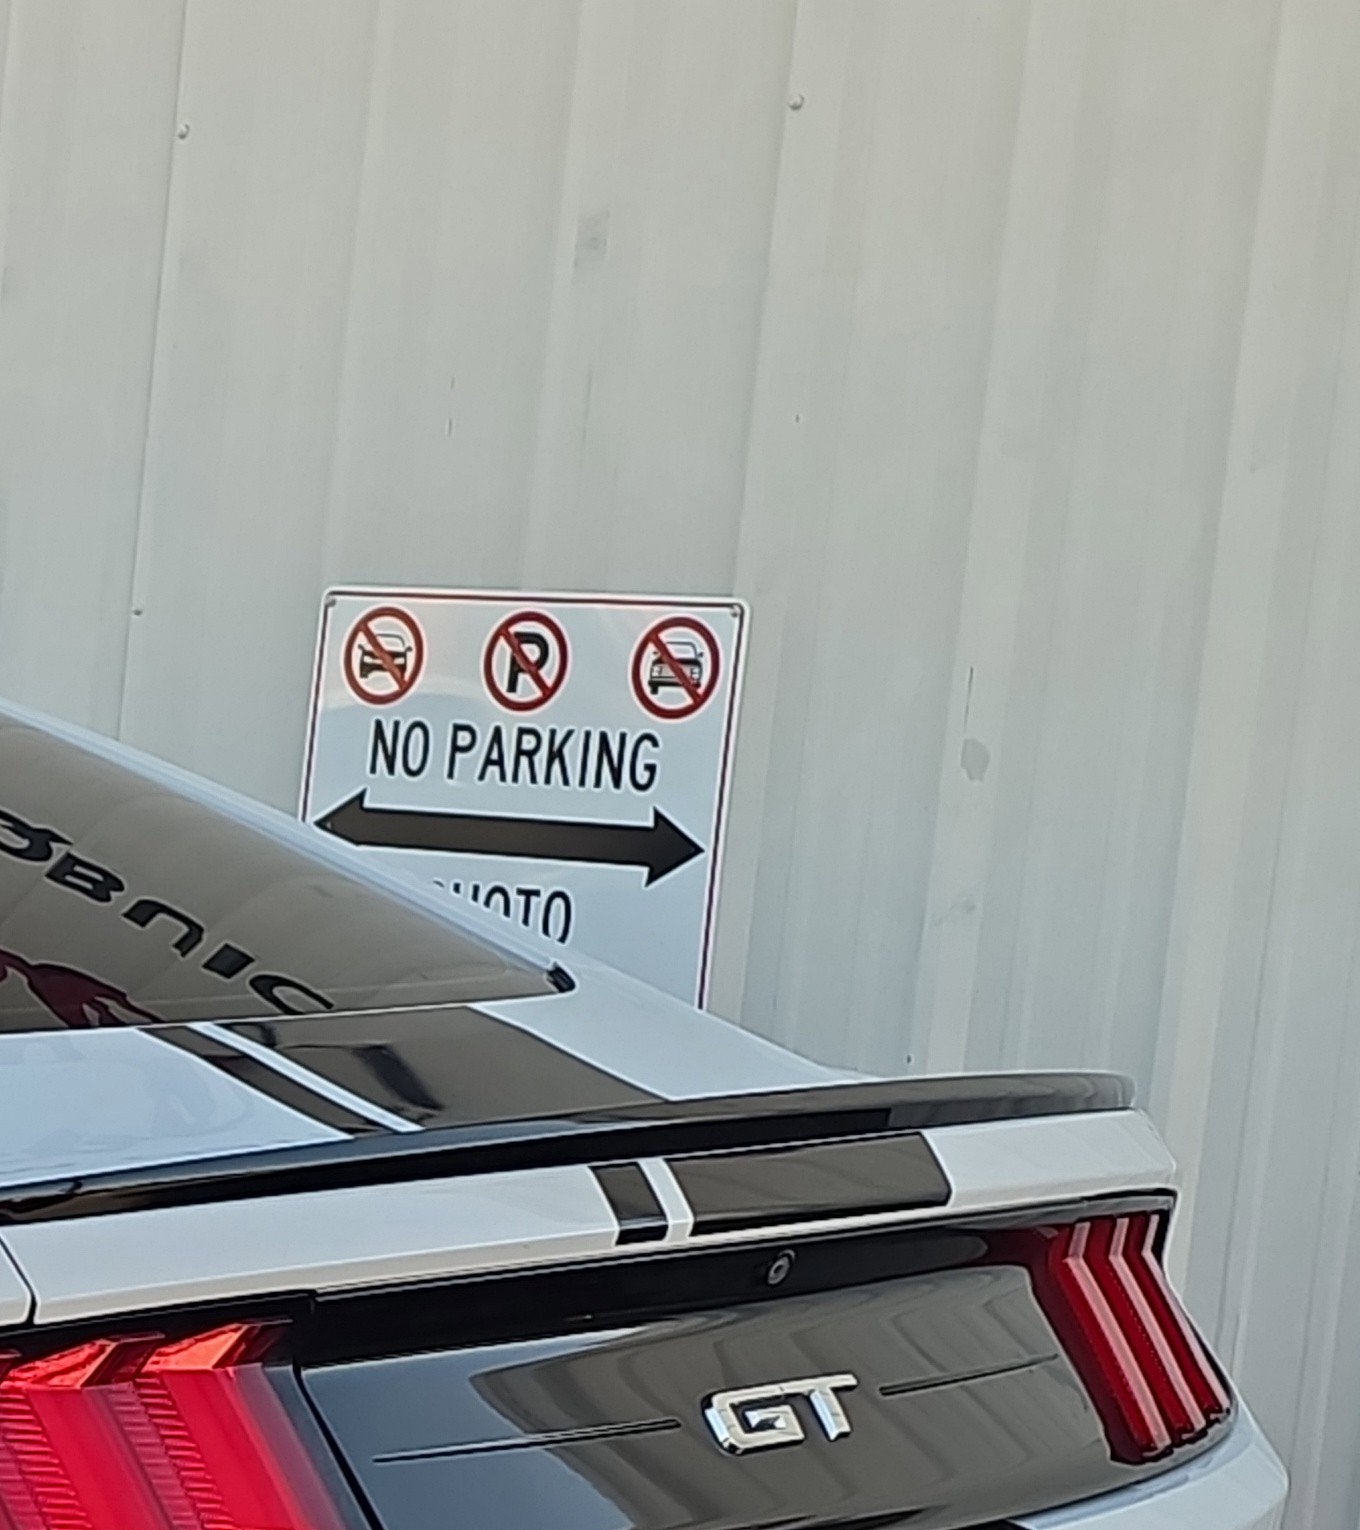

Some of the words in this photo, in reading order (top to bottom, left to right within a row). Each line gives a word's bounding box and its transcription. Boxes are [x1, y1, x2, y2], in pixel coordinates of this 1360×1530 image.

[369, 718, 430, 778] NO
[446, 723, 661, 792] PARKING
[701, 1371, 859, 1456] GT
